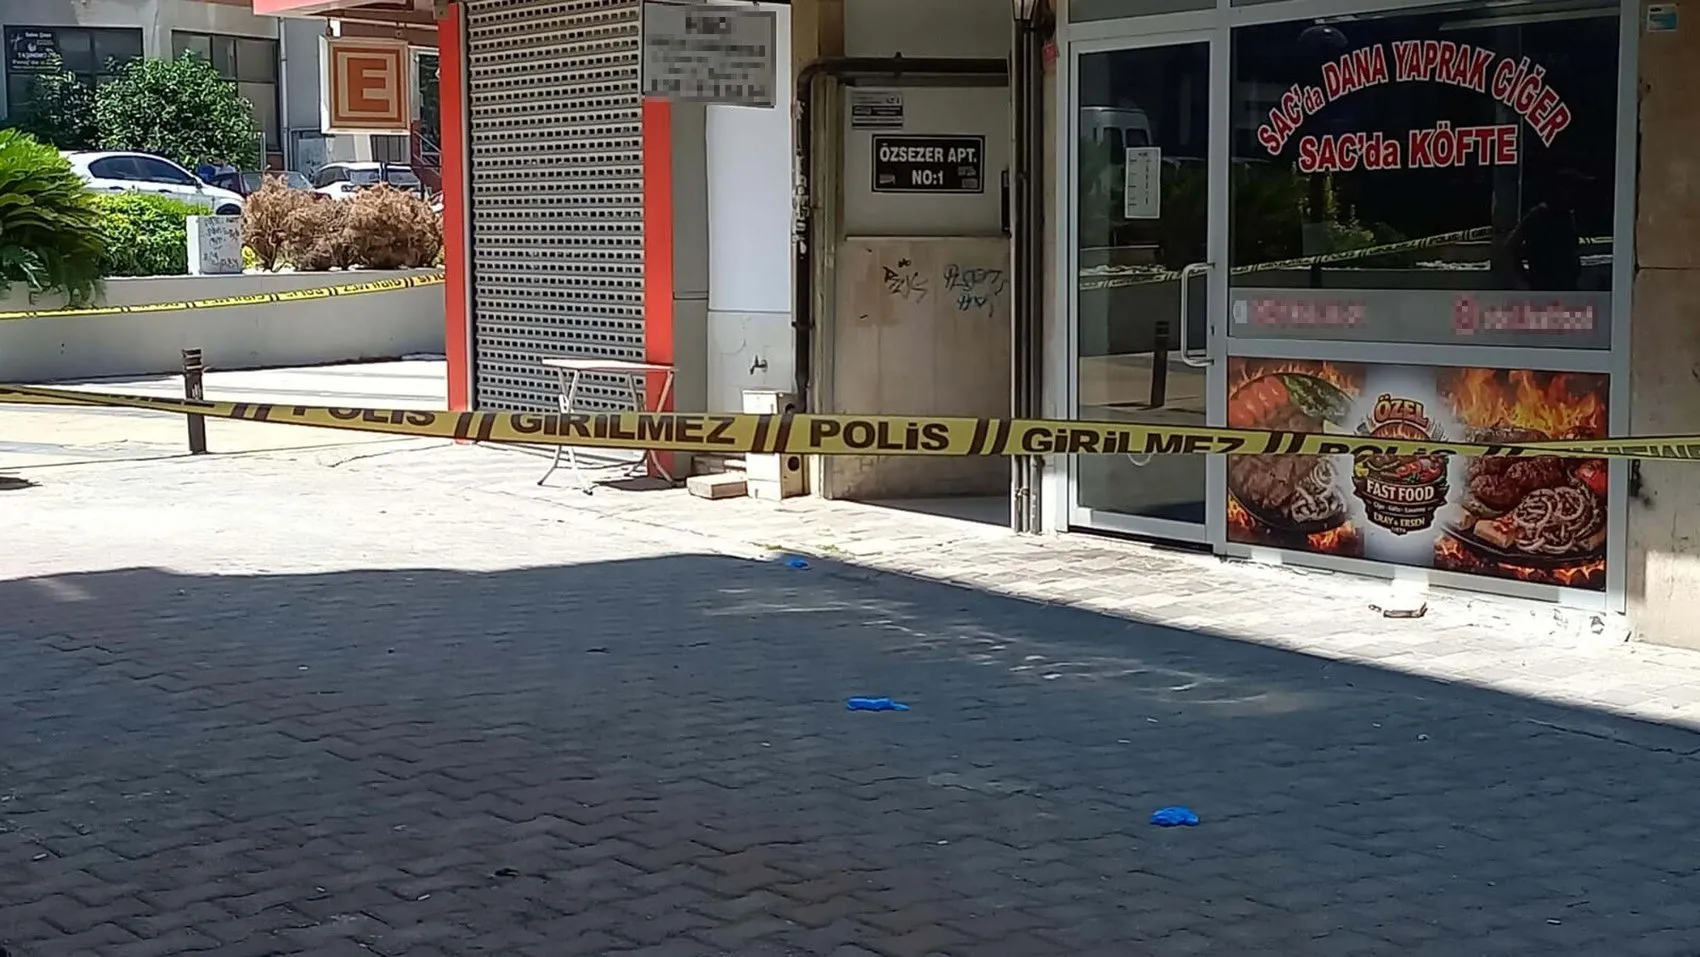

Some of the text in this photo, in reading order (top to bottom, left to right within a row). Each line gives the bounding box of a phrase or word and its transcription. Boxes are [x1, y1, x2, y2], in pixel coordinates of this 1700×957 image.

[1322, 43, 1389, 102] DANA
[1392, 40, 1497, 94] YAPRAK
[879, 142, 978, 163] ÖZSEZER APT.
[1299, 120, 1519, 173] SAC'da KÖFTE
[911, 169, 944, 185] NO:1
[1374, 393, 1430, 427] ÖZEL
[1366, 479, 1435, 502] FAST FOOD
